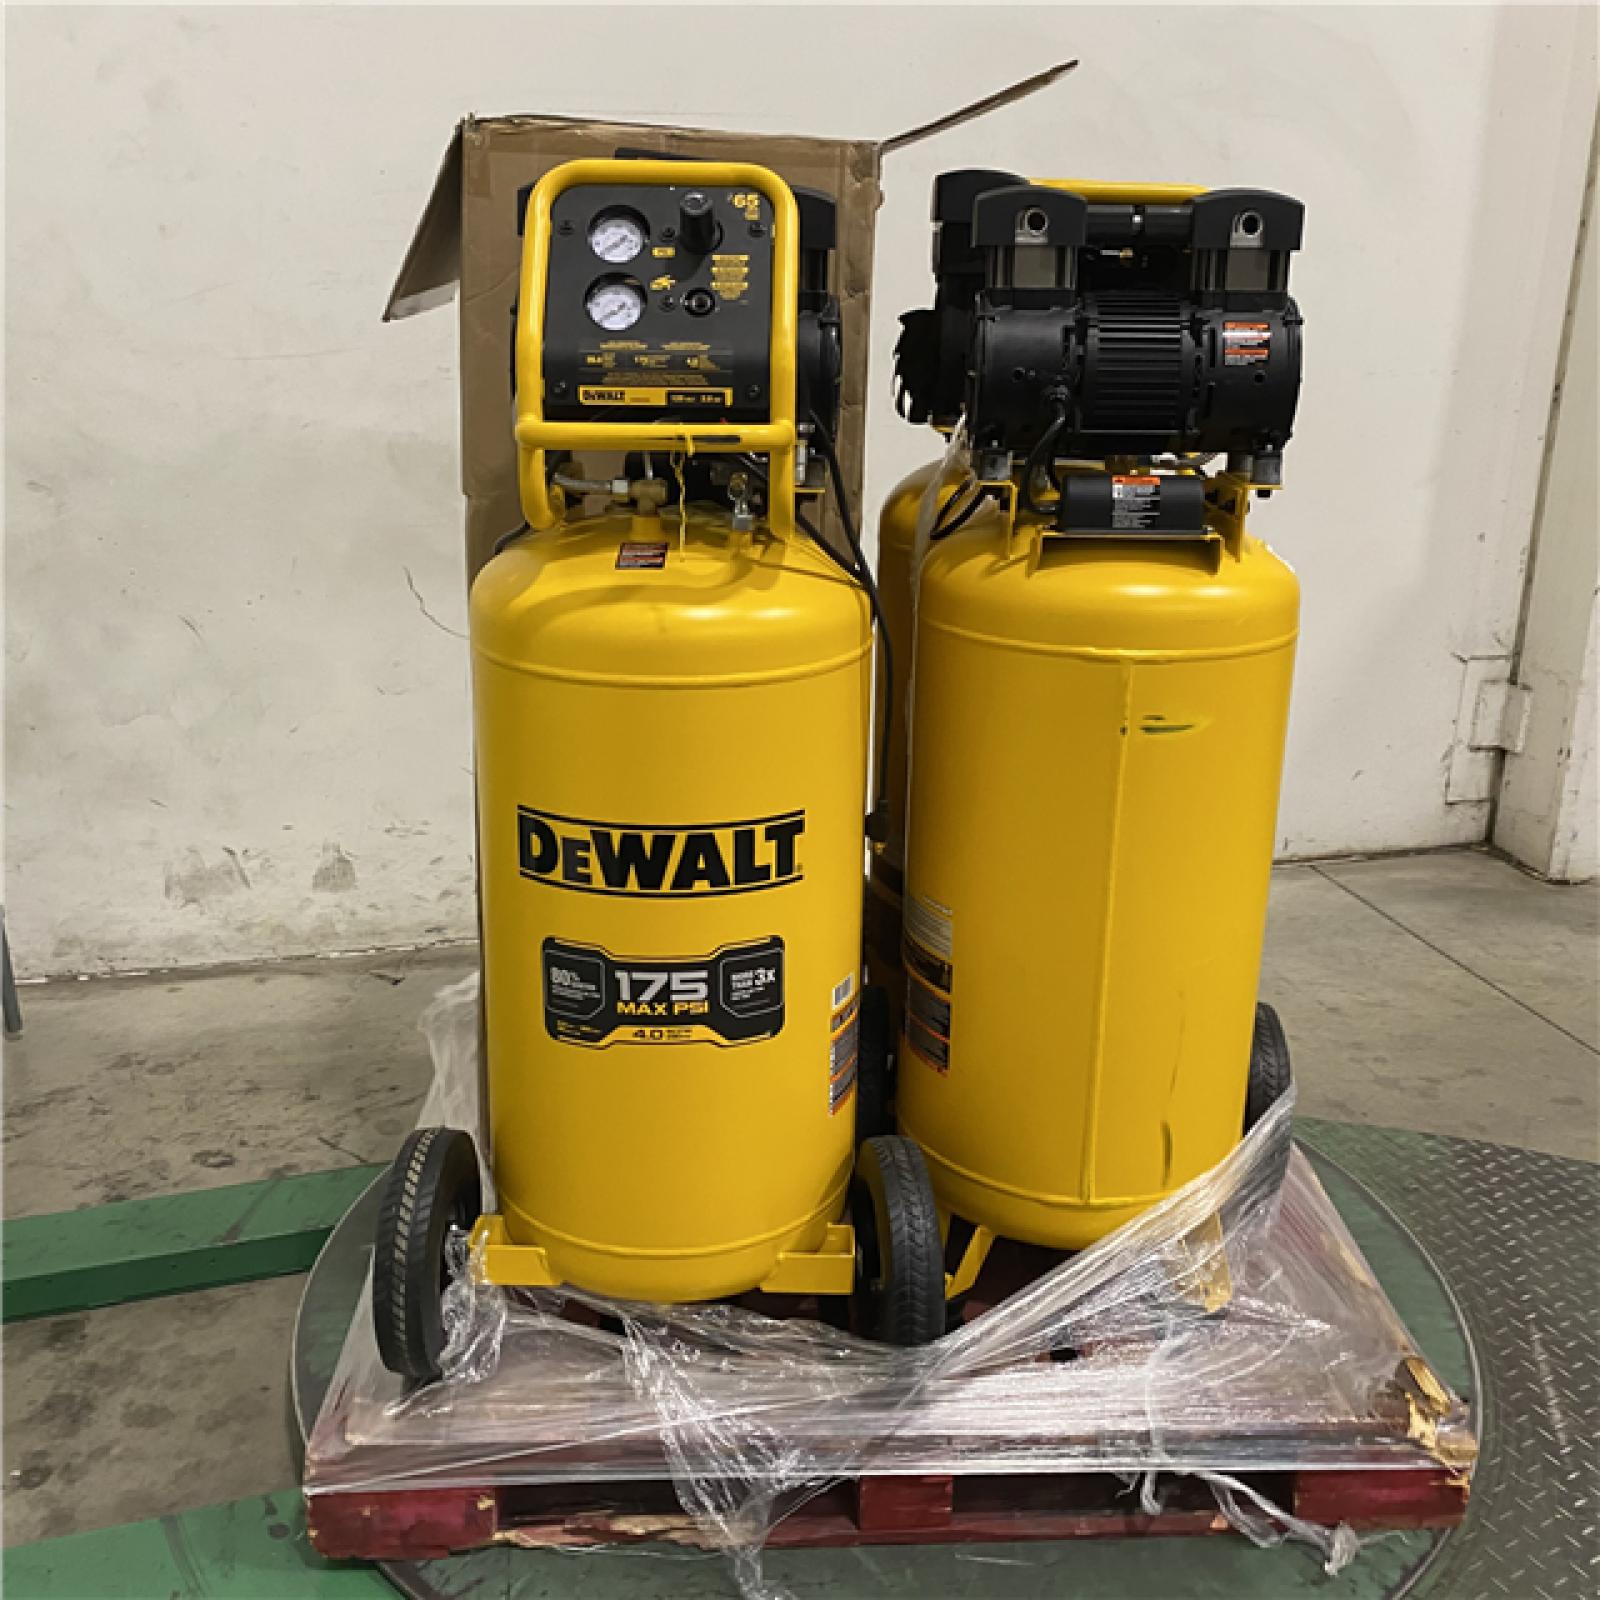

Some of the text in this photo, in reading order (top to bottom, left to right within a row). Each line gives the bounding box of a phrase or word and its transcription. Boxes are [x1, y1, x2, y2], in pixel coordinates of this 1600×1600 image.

[733, 193, 759, 208] 65
[518, 814, 804, 888] DEWALT
[615, 970, 708, 1001] 175
[617, 1000, 710, 1015] MAX PSI
[633, 1028, 664, 1040] 4.0
